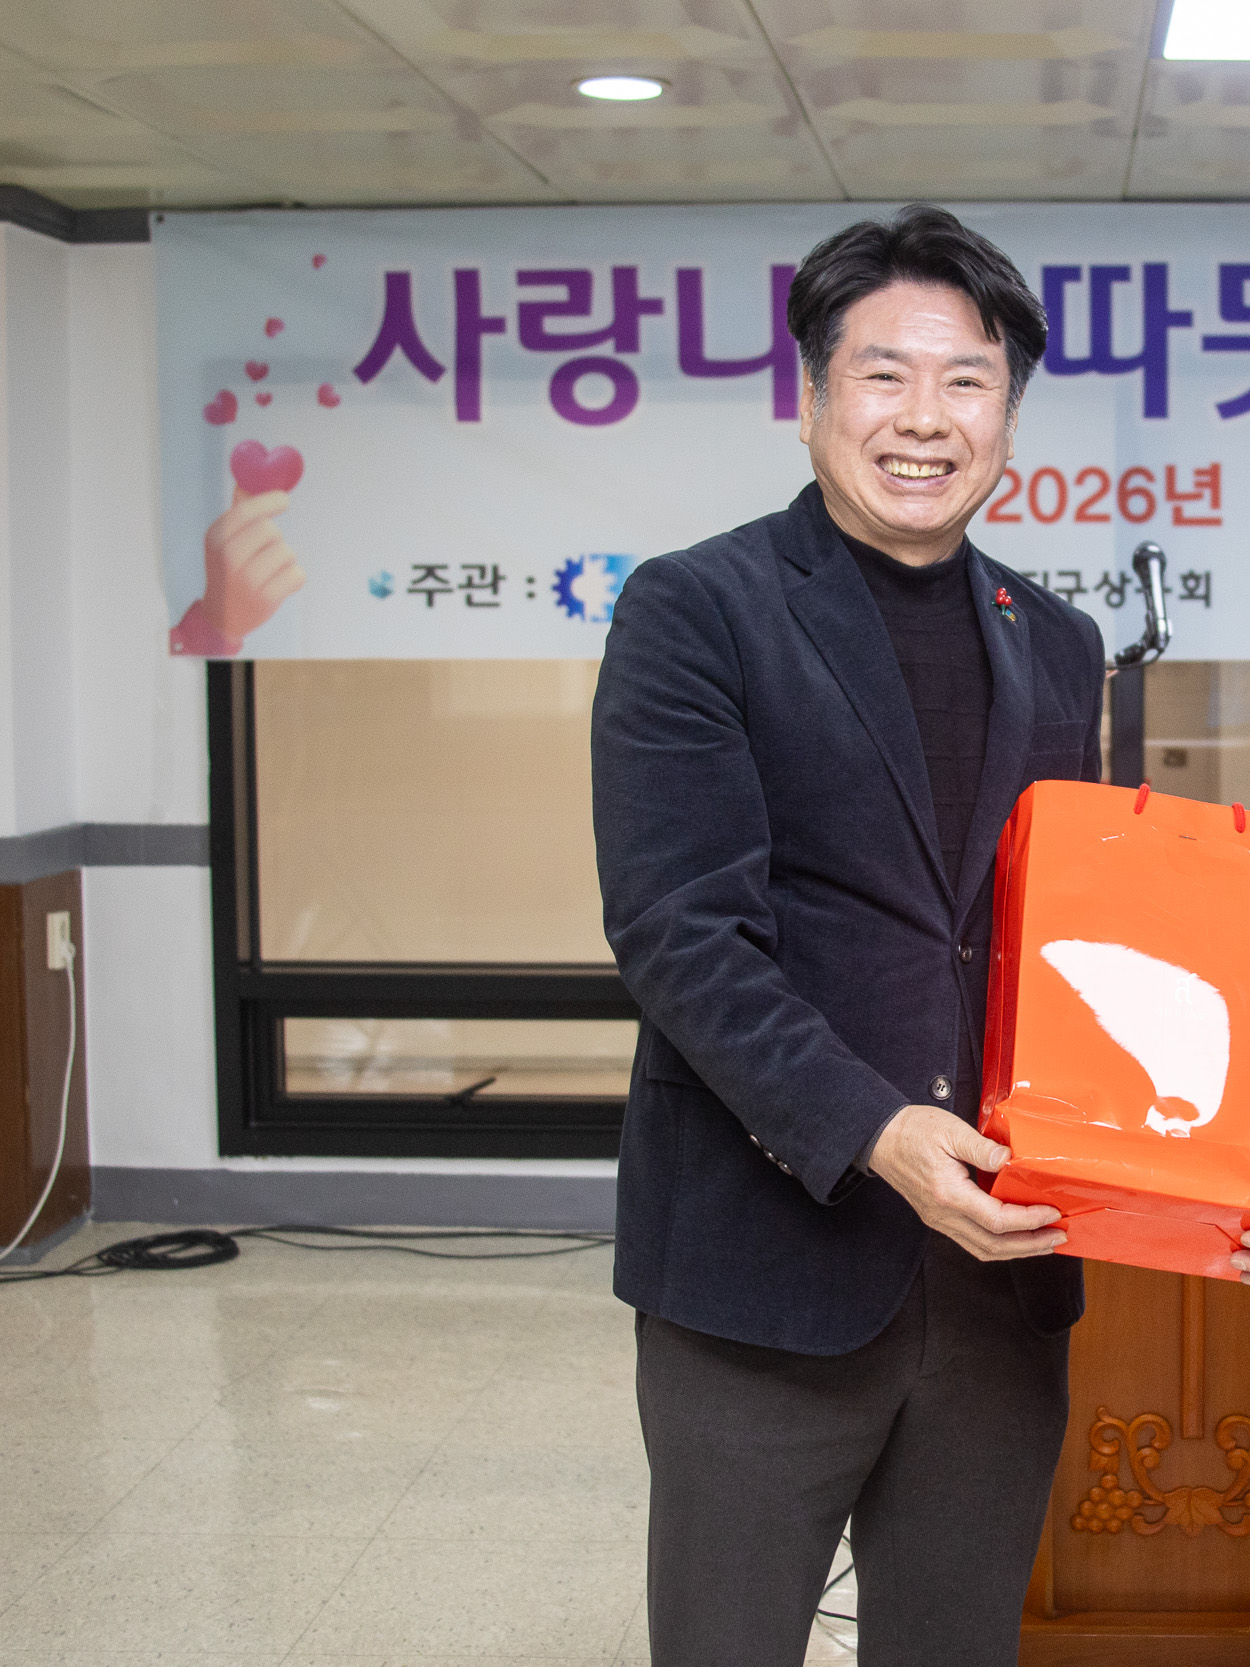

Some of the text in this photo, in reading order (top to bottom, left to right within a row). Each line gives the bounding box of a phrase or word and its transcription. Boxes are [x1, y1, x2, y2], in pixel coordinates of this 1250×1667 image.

[352, 263, 799, 426] 사랑나
[986, 461, 1223, 528] 2026년
[406, 563, 507, 609] 주관
[1021, 568, 1212, 609] 구상회
